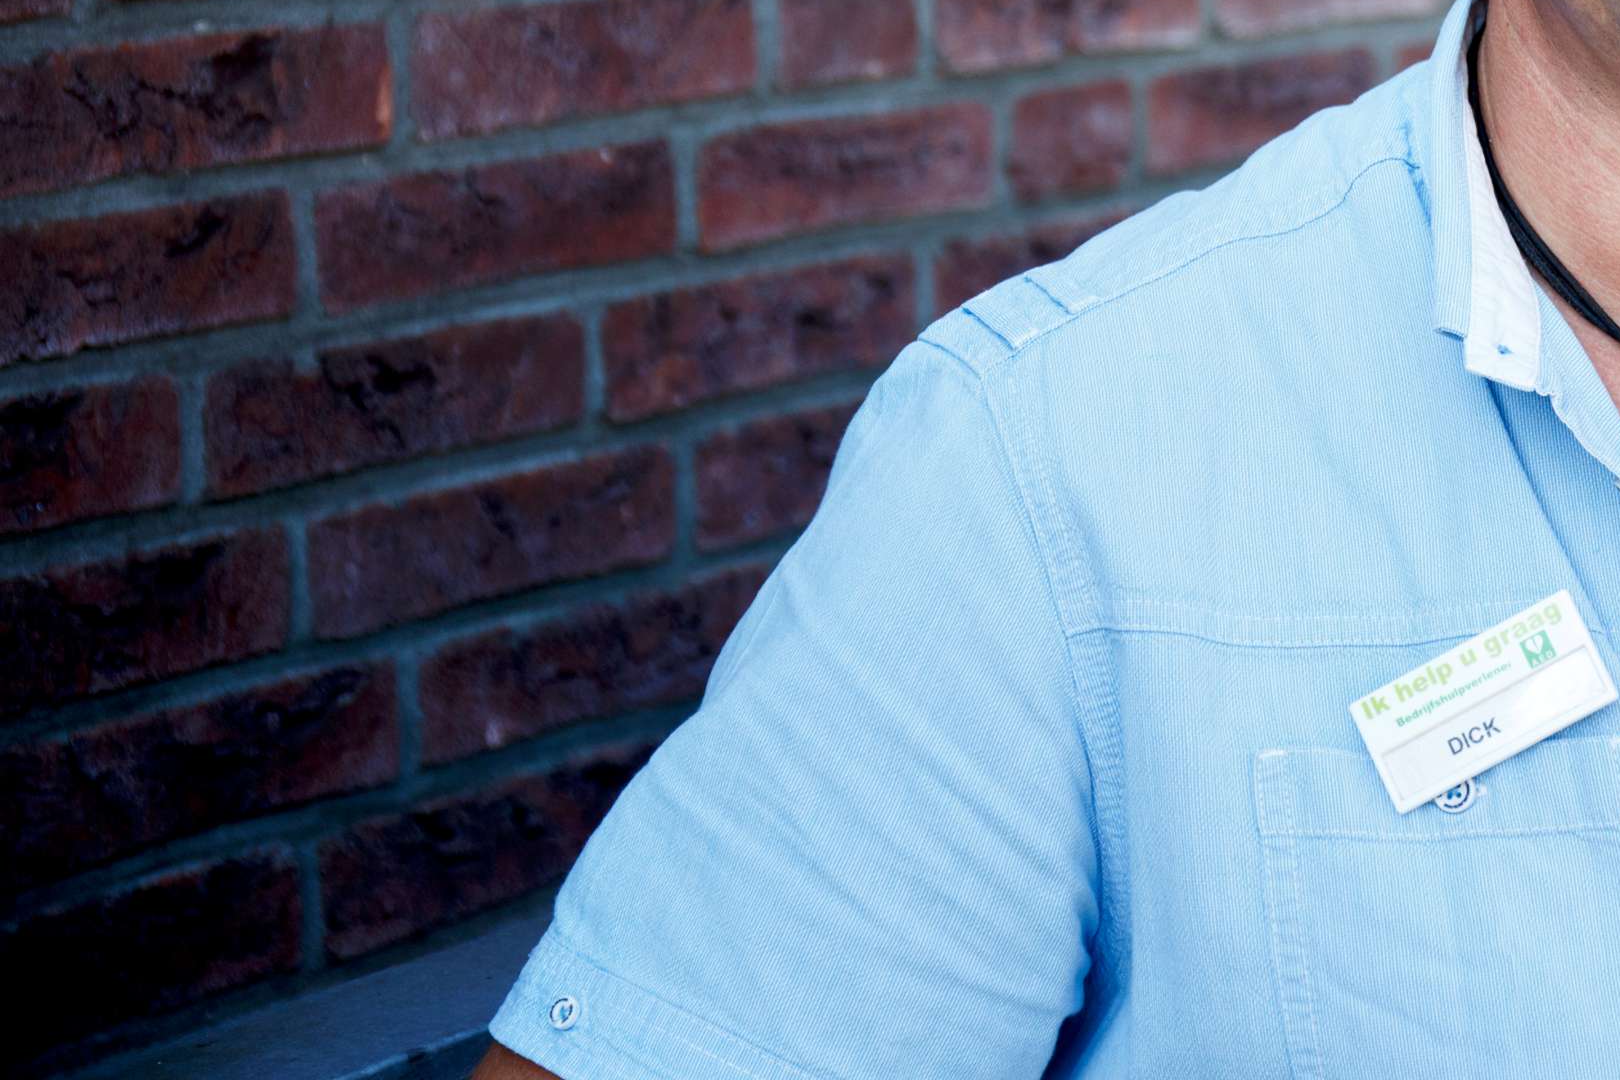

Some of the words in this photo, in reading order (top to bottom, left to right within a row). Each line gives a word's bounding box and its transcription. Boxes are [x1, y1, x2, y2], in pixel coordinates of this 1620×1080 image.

[1360, 695, 1391, 719] Ik
[1394, 663, 1452, 702] help
[1459, 648, 1478, 666] u
[1484, 601, 1562, 658] graag
[1448, 718, 1501, 755] DICK
